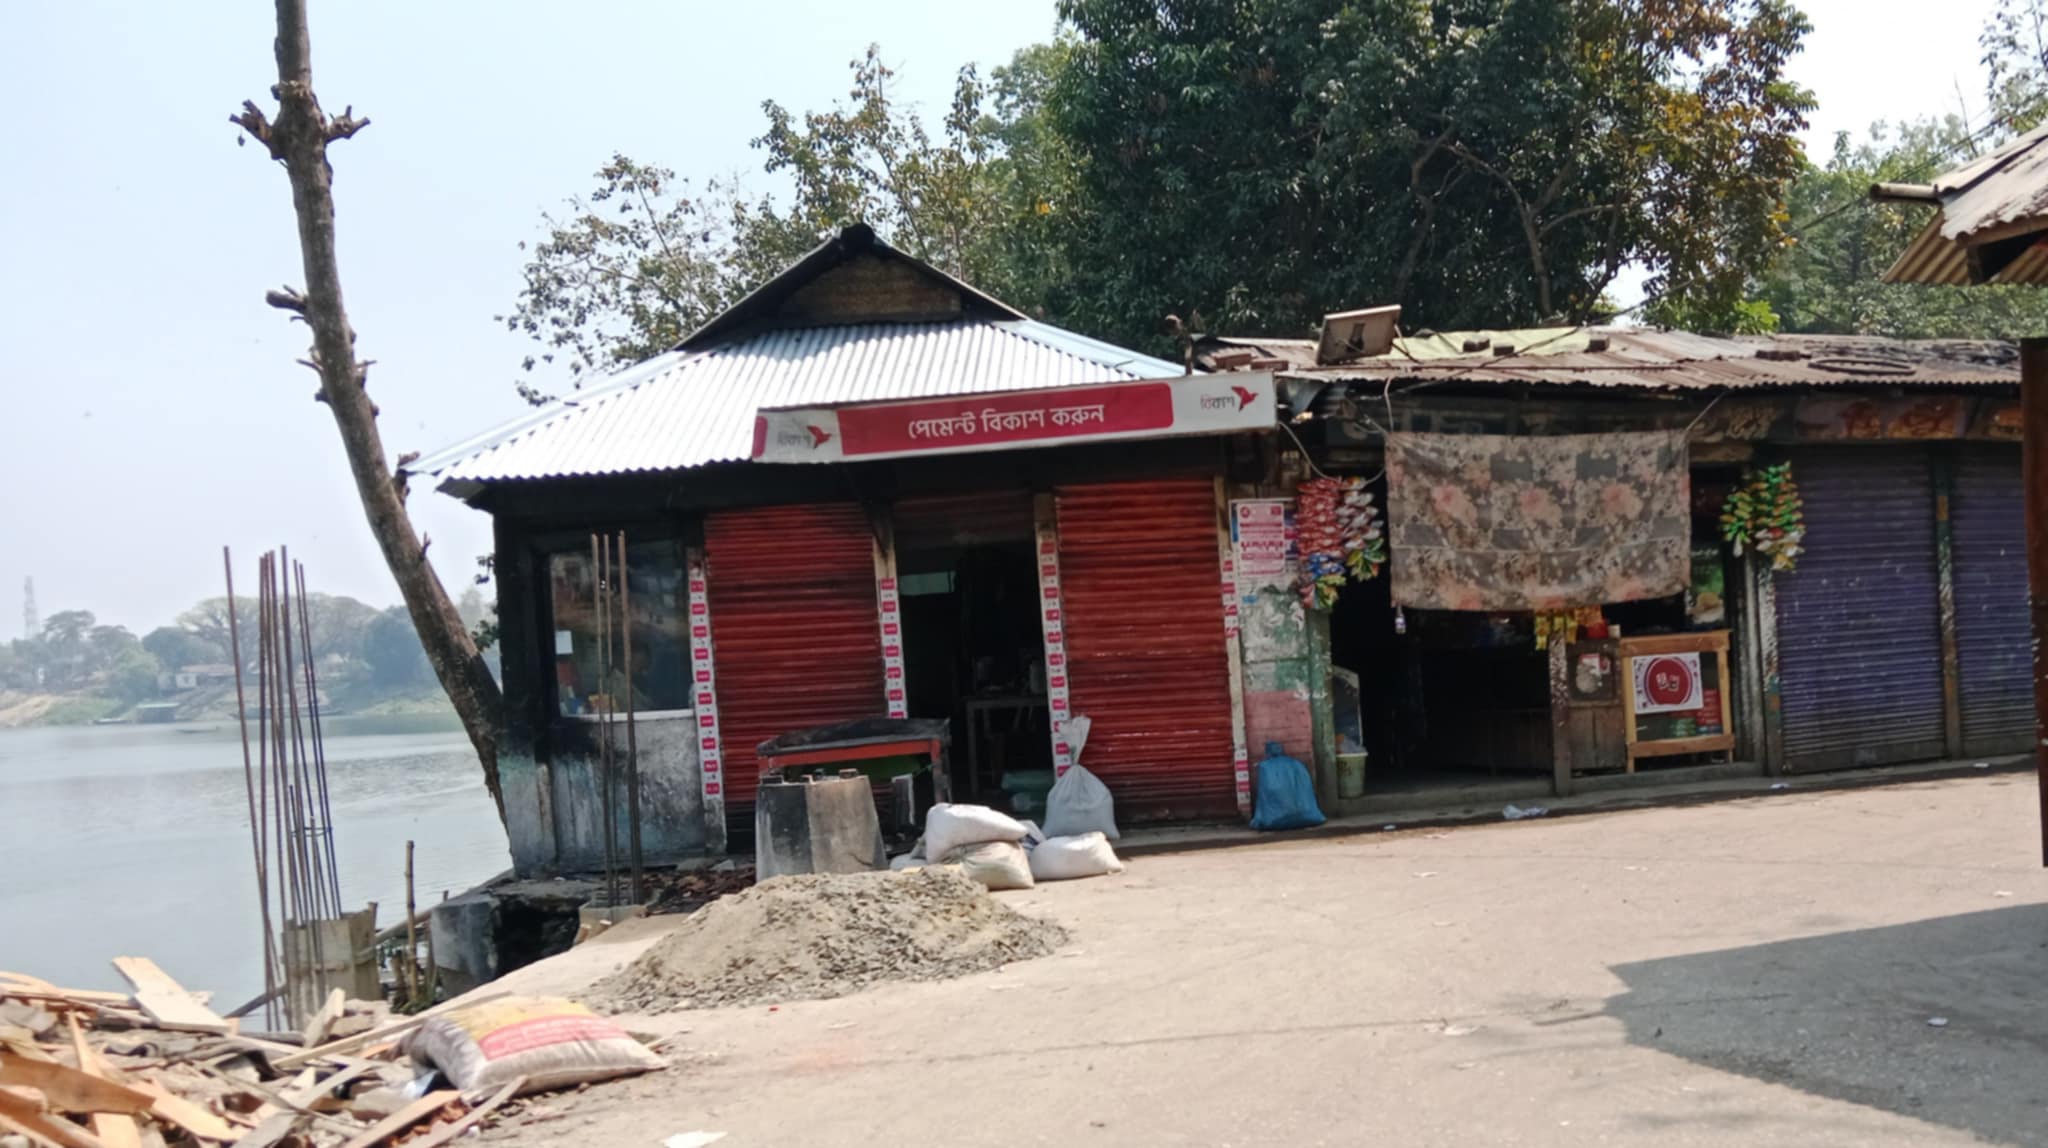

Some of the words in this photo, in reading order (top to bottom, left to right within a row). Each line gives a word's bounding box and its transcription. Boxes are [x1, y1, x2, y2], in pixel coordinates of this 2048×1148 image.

[908, 411, 976, 438] পেমেন্ট
[980, 408, 1046, 432] বিকাশ
[1049, 404, 1105, 425] করুন
